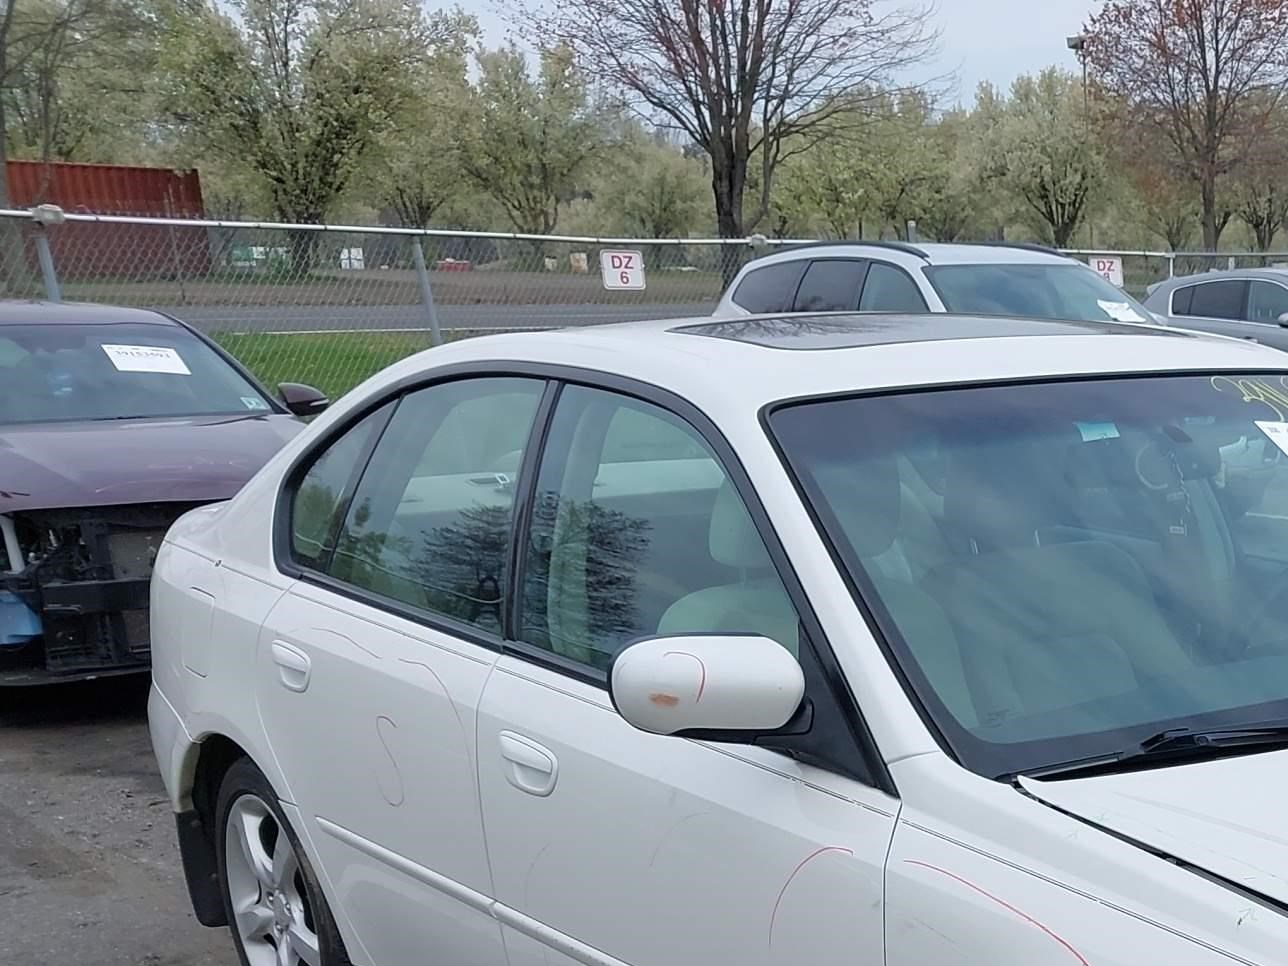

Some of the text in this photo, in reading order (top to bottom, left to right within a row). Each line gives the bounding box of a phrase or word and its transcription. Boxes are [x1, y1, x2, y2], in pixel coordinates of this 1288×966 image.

[611, 255, 634, 269] DZ
[1097, 260, 1115, 272] DZ
[620, 271, 629, 285] 6
